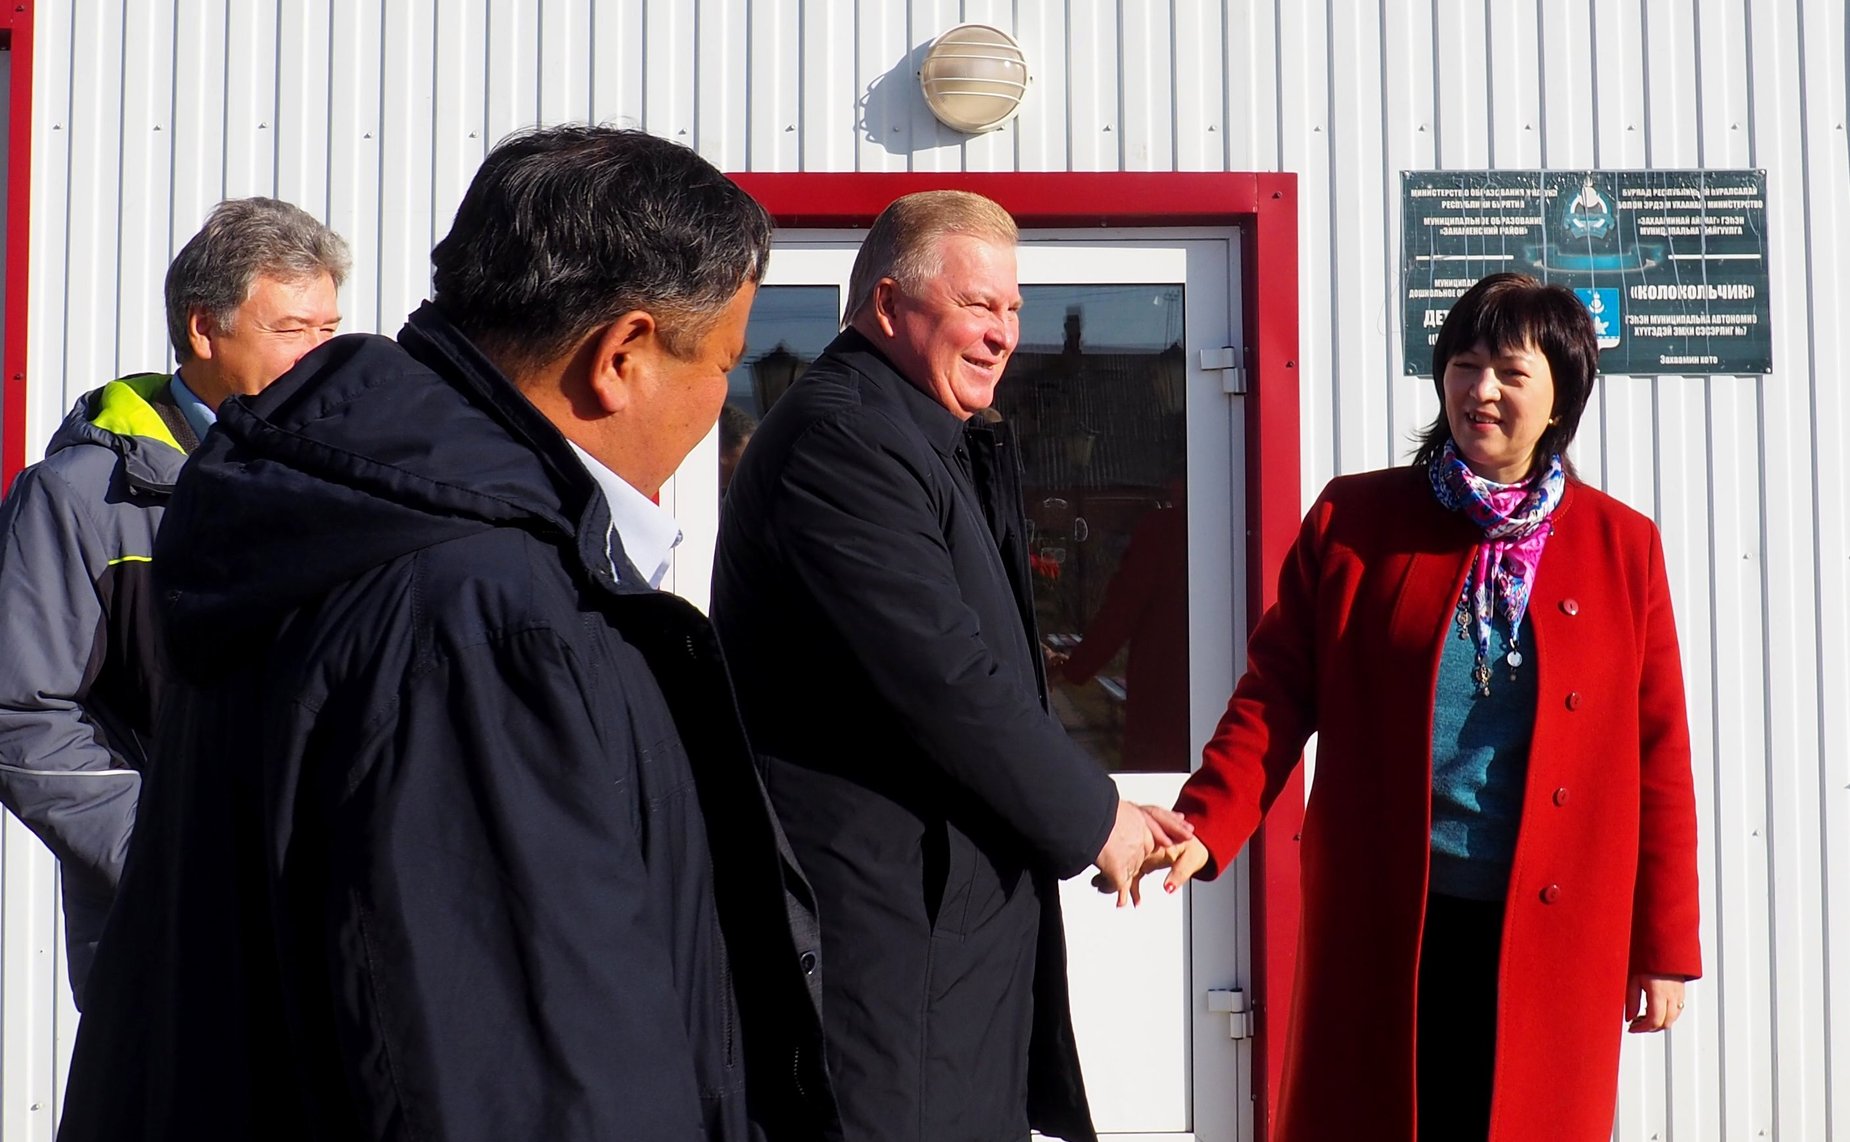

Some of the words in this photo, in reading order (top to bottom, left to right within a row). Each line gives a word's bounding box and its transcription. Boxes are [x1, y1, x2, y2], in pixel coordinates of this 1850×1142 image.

[1441, 200, 1490, 209] РЕСПУБЛИКИ
[1707, 200, 1763, 209] МИНИСТЕРСТВО
[1423, 217, 1489, 226] МУНИЦИПАЛЬНОЕ
[1491, 216, 1543, 225] ОБРАЗОВАНИЕ
[1409, 289, 1456, 299] ДОШКОЛЬНОЕ
[1630, 284, 1755, 300] «КОЛОКОЛЬЧИК»
[1650, 314, 1710, 325] МУНИЦИПАЛЬНА
